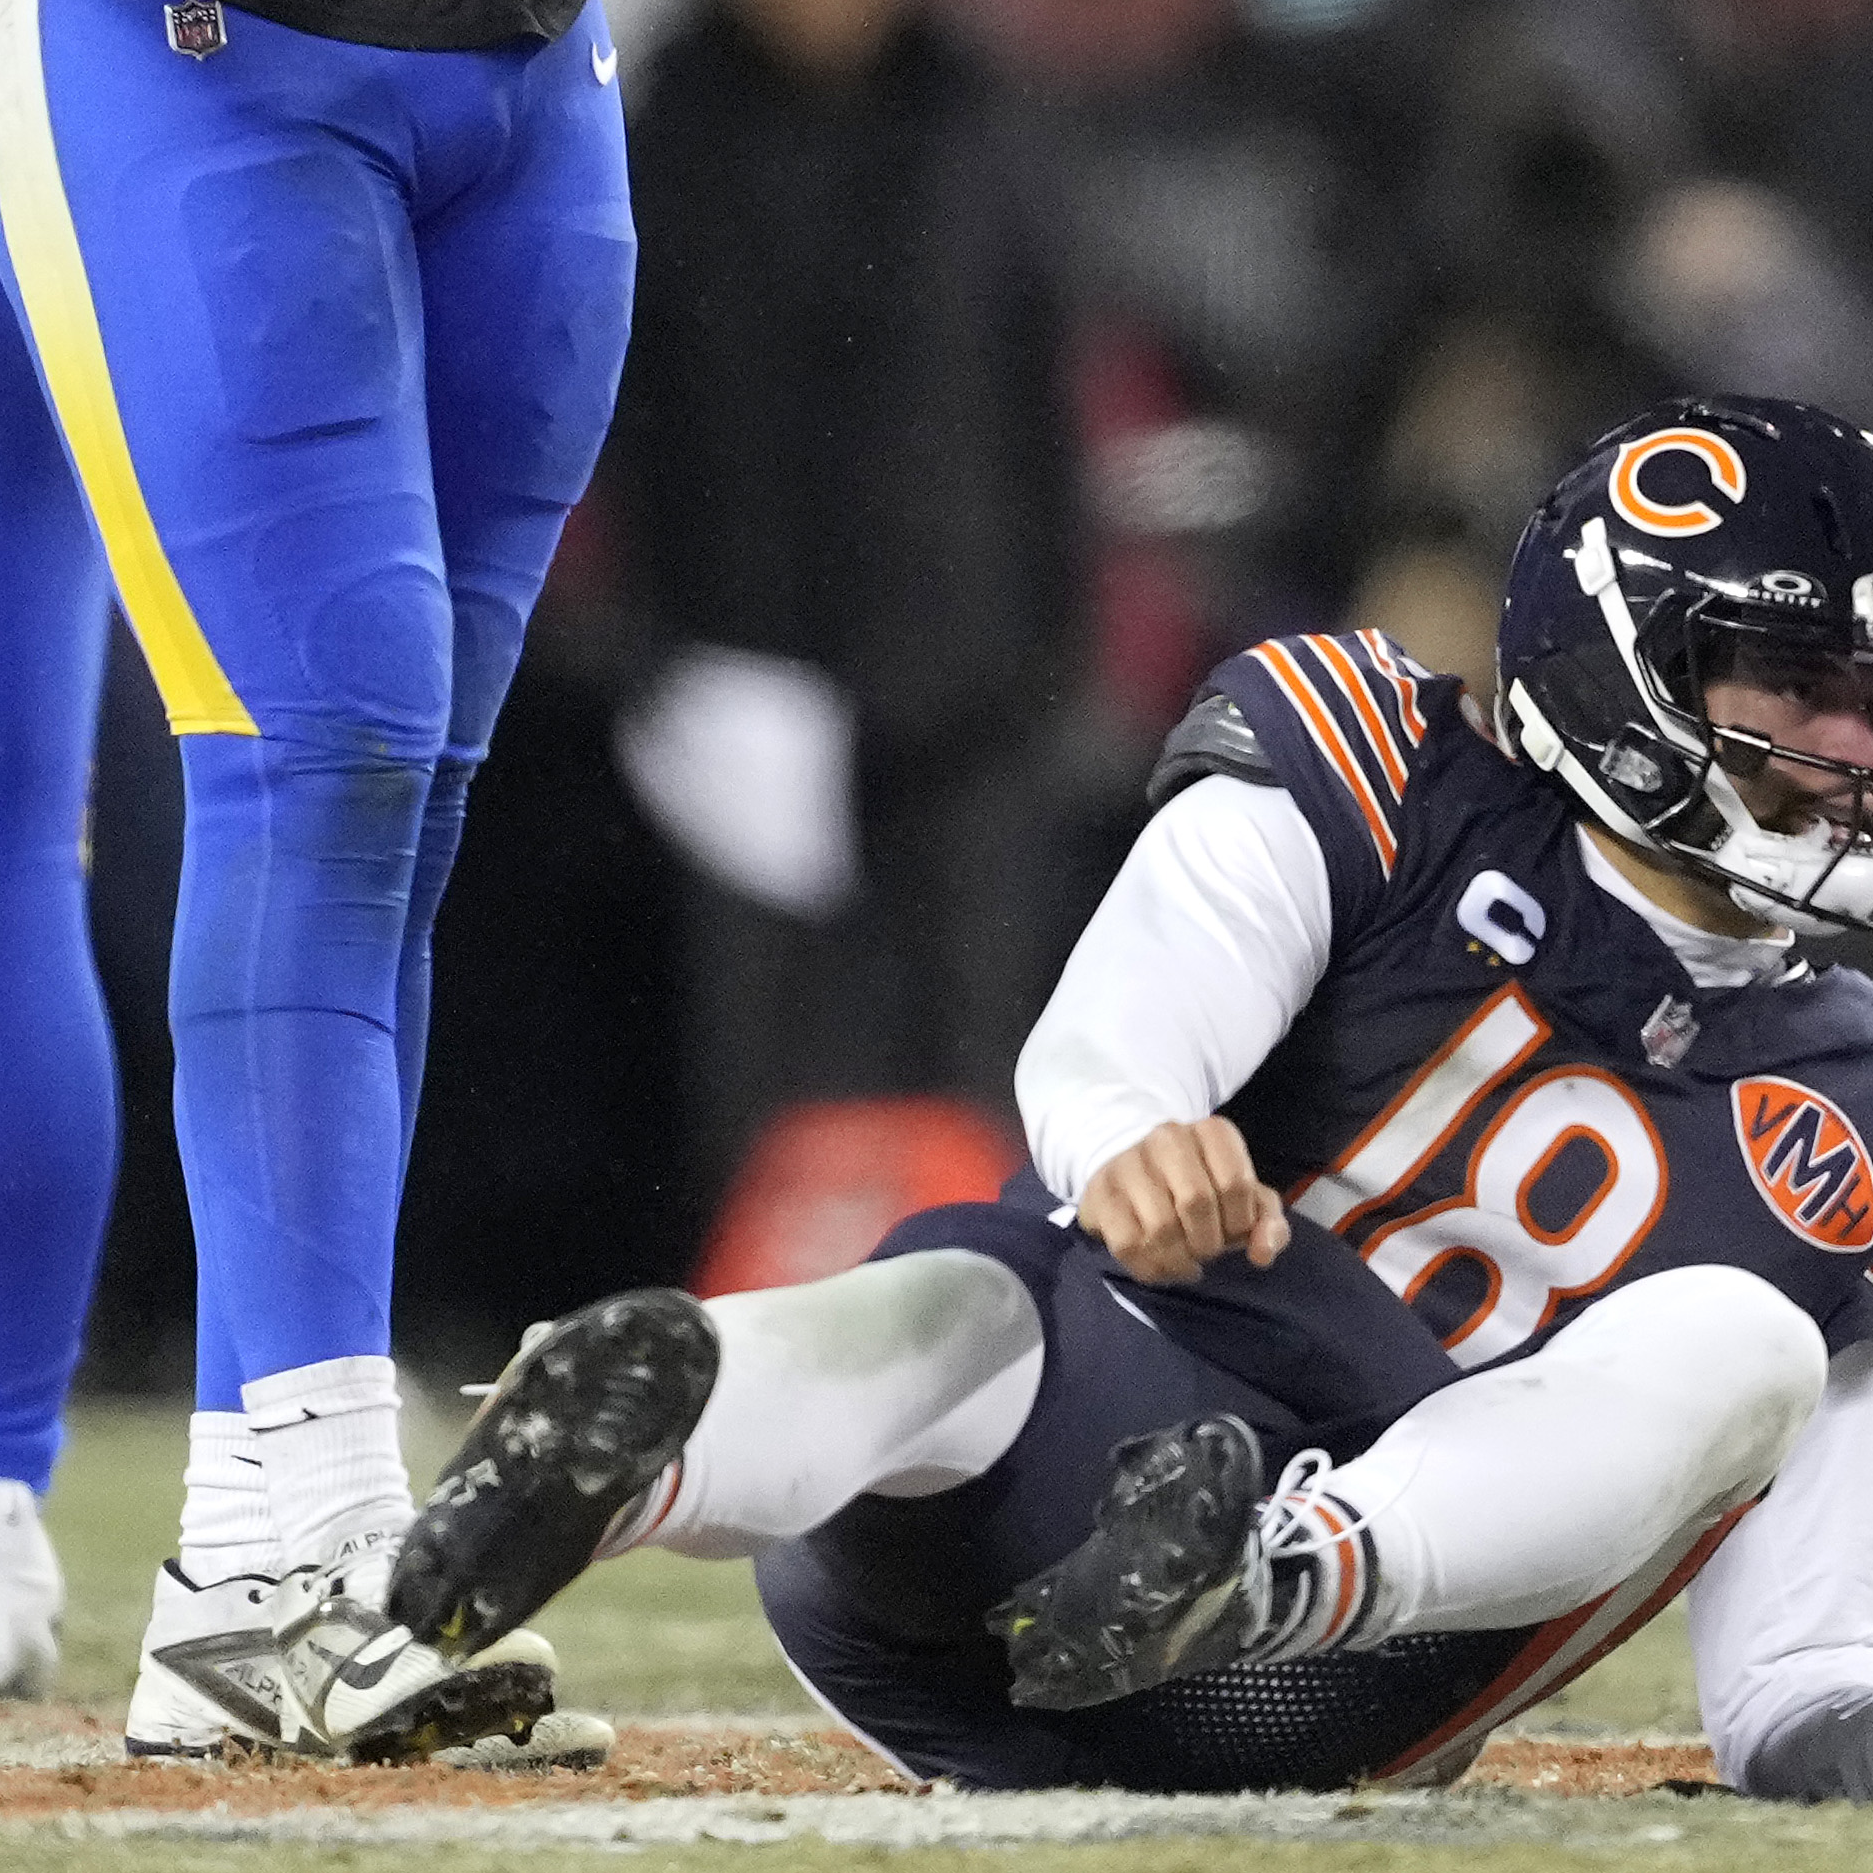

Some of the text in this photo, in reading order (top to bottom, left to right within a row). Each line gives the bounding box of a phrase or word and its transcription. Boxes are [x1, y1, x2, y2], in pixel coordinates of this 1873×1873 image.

[1609, 428, 1746, 537] C
[1456, 870, 1546, 965] C
[1286, 979, 1669, 1371] 18
